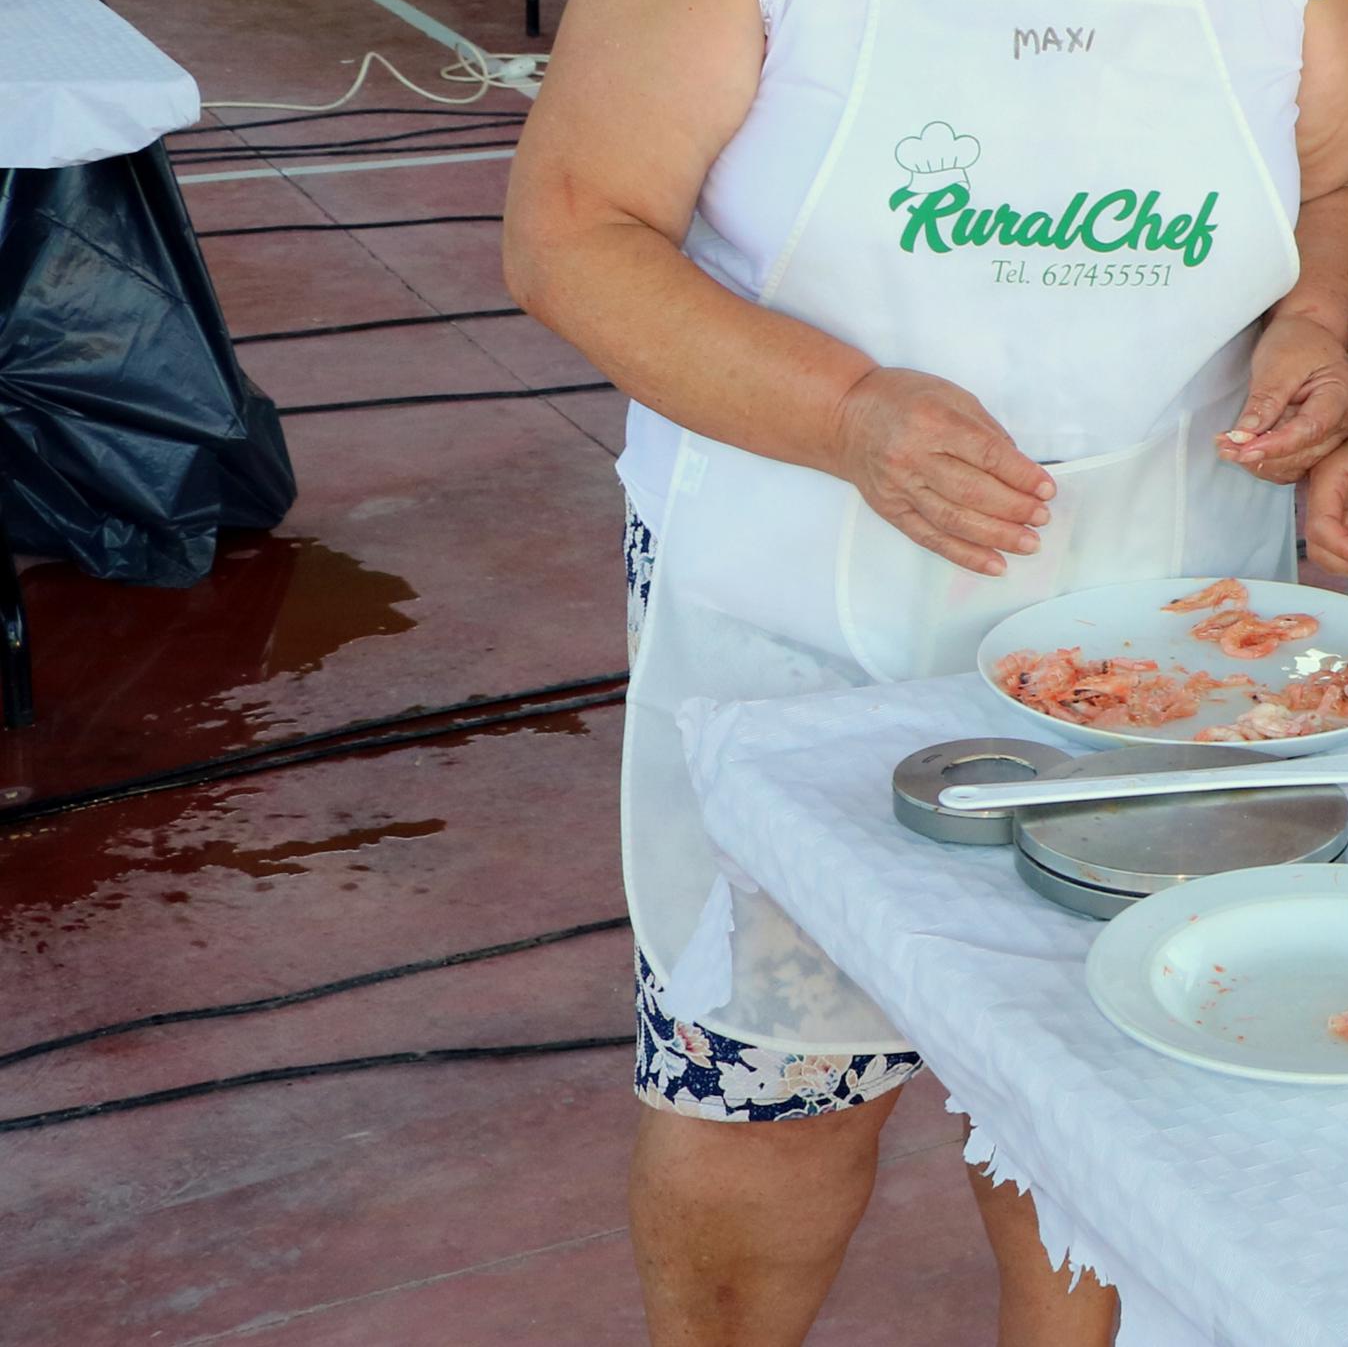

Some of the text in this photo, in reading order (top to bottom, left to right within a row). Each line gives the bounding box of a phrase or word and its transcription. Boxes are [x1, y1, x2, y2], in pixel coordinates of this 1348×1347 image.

[1013, 26, 1096, 60] MAXI
[889, 182, 1219, 268] RuralChef
[991, 259, 1173, 287] Tel. 627455551
